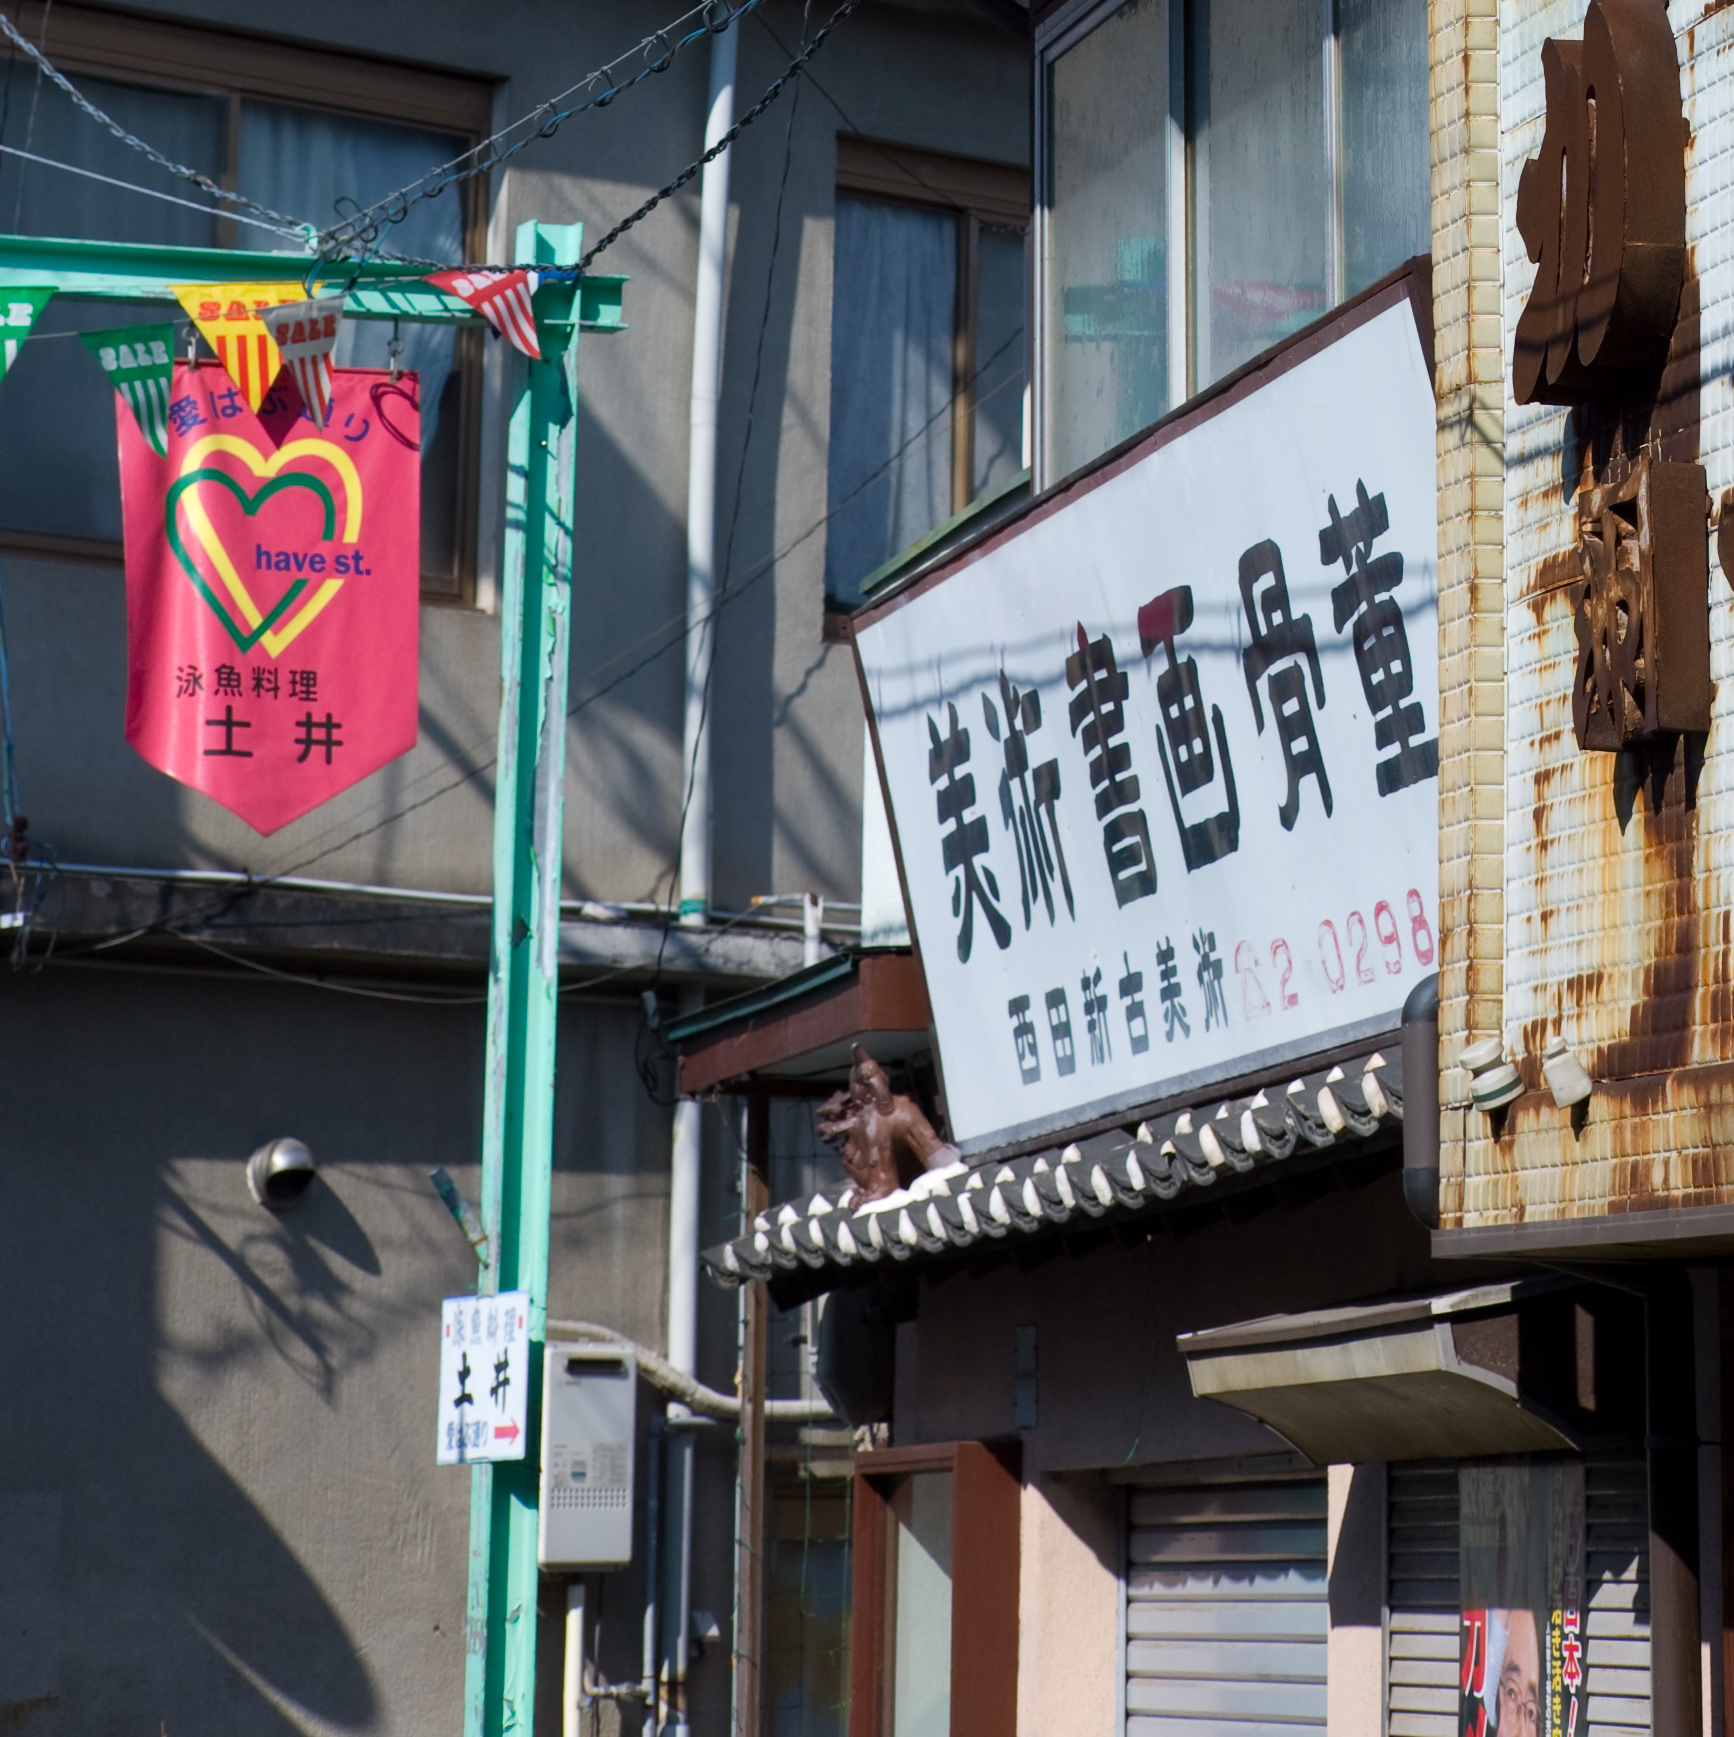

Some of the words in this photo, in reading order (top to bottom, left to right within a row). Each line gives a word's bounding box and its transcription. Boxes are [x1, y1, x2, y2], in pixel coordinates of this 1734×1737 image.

[198, 299, 299, 322] SAL
[276, 313, 336, 346] SALE
[98, 340, 168, 372] SALE
[255, 544, 326, 573] have
[333, 548, 372, 576] st.
[175, 662, 319, 703] 泳魚料理
[1007, 926, 1229, 1087] 西田新古美術
